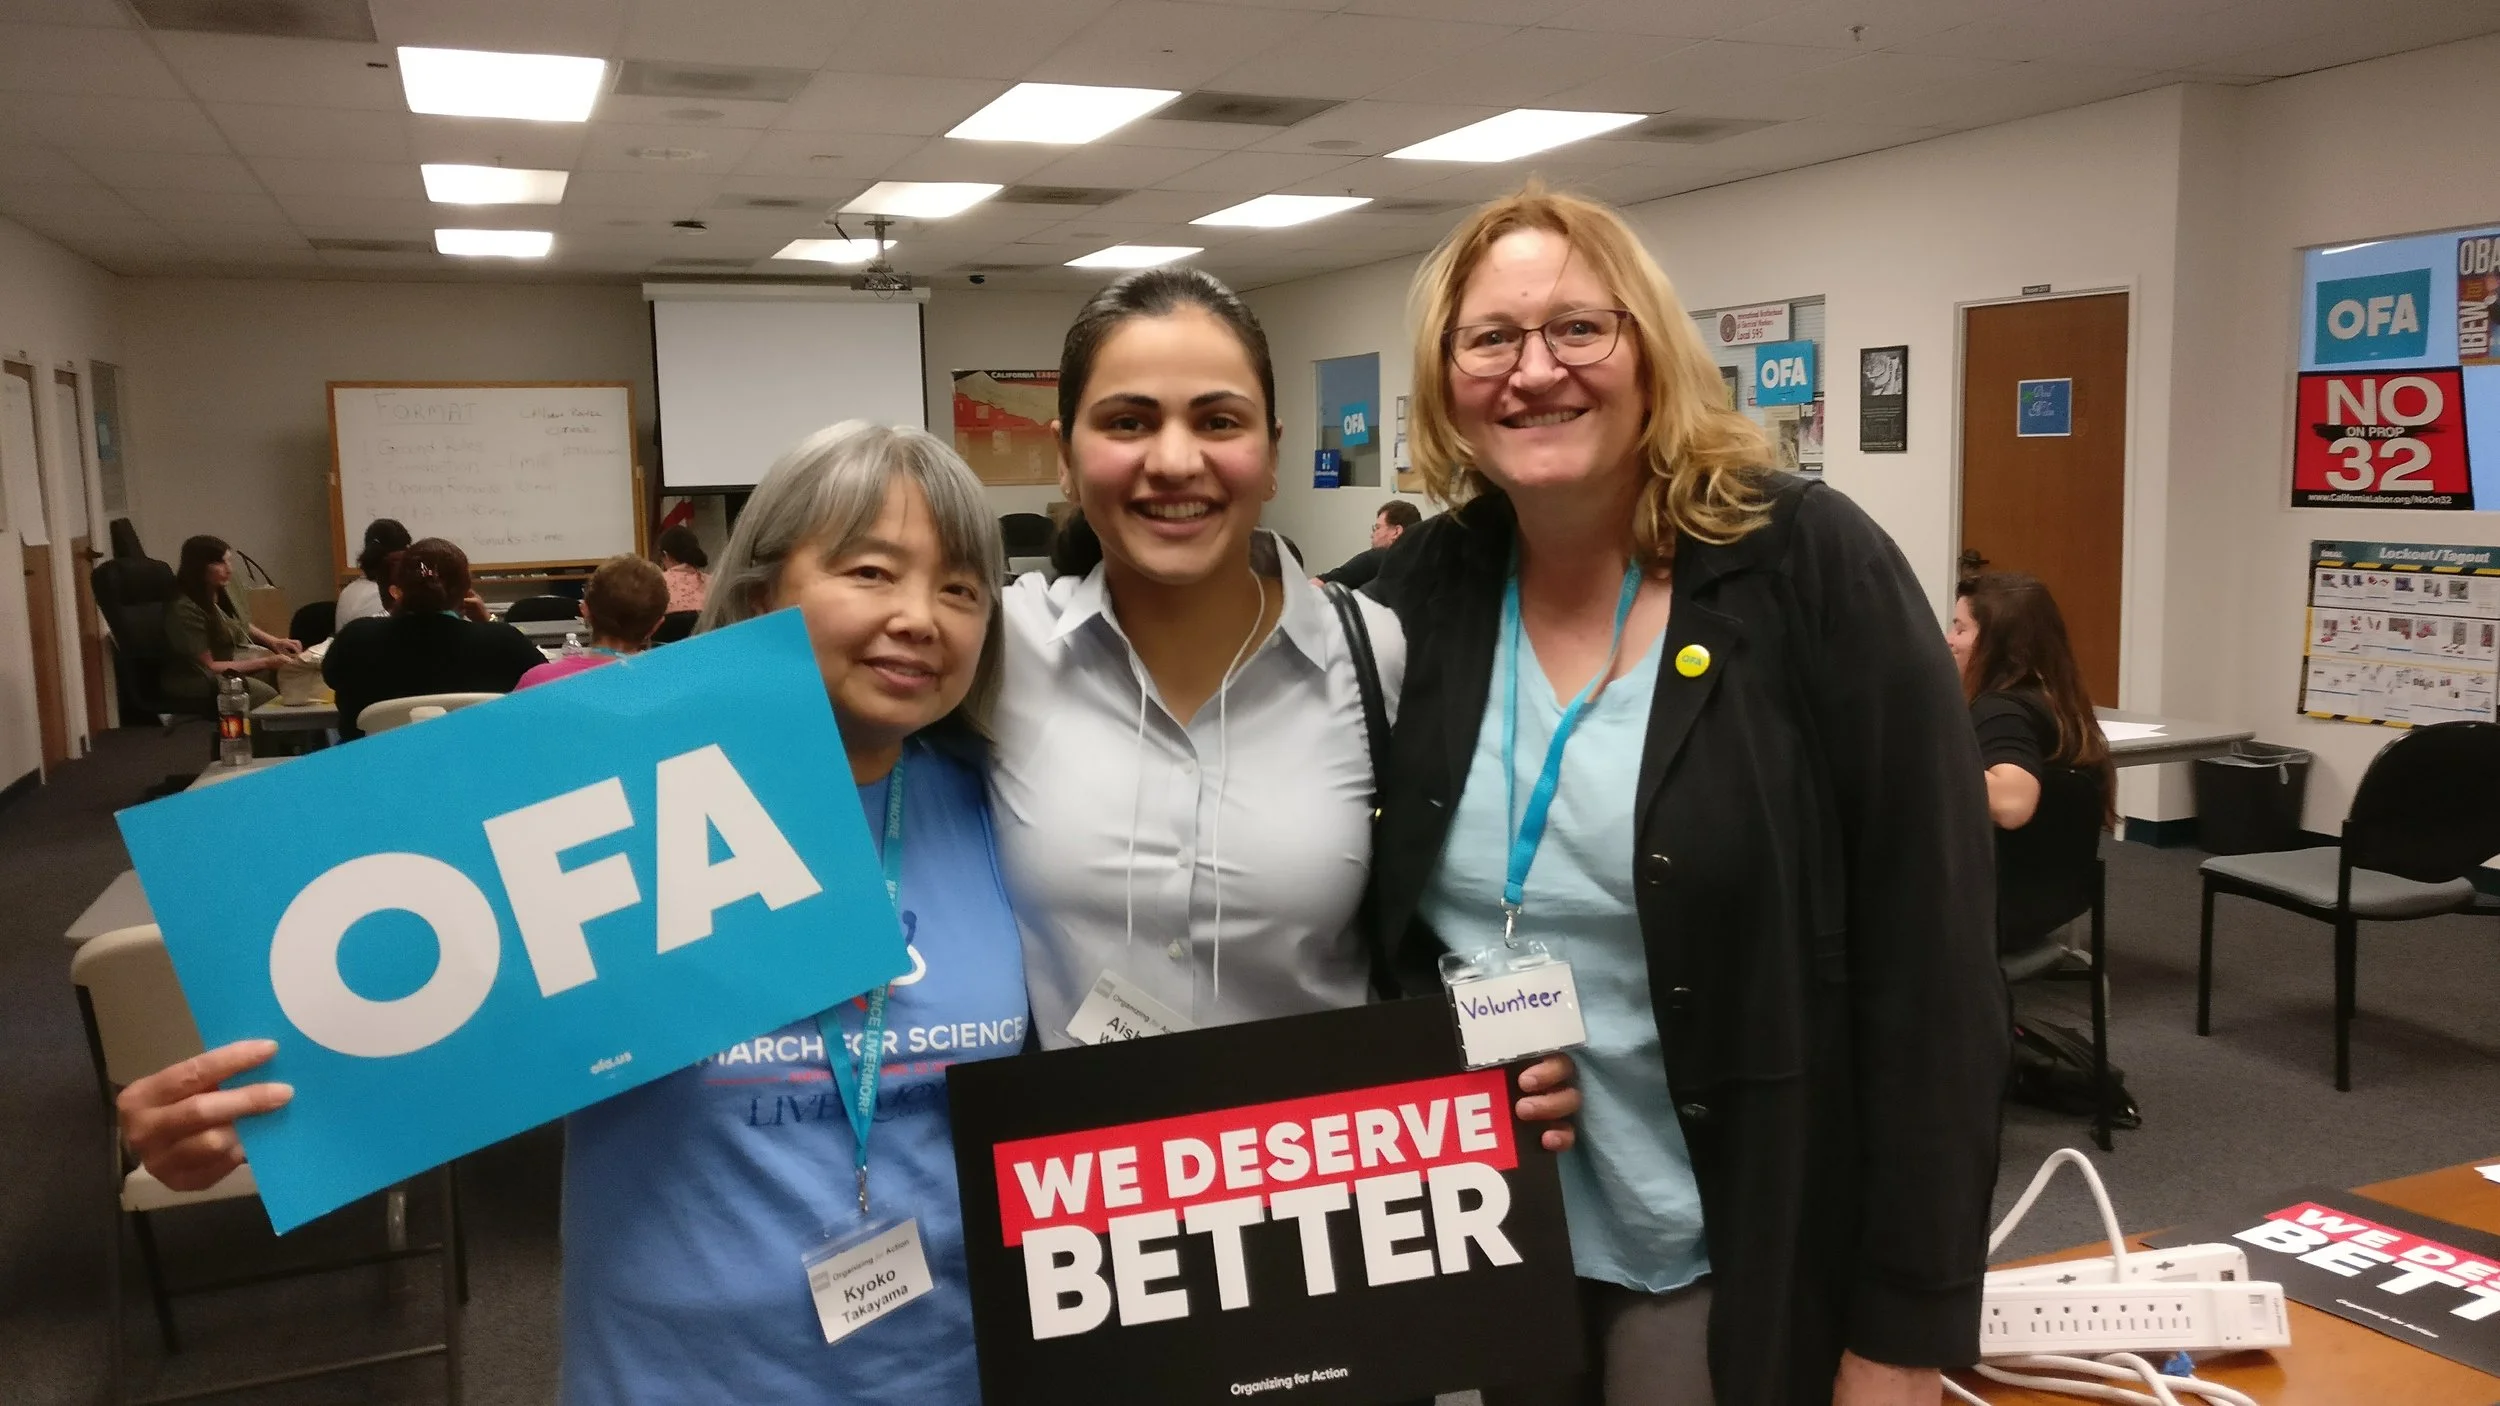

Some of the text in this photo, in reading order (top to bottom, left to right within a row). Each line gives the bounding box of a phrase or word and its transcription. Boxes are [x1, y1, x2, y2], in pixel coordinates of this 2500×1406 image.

[2327, 293, 2420, 340] OFA
[2459, 295, 2498, 355] IBEW
[1737, 330, 1750, 340] Local
[991, 371, 1035, 379] CALIFORNIA
[1761, 356, 1807, 388] OFA
[374, 393, 478, 422] FORMAT
[2326, 377, 2444, 427] NO
[1344, 412, 1365, 436] OFA
[2346, 426, 2405, 438] ON PROP
[2326, 437, 2434, 491] 32
[2308, 493, 2453, 505] www.CaliforniaLabor.org/NoOn32
[2379, 547, 2491, 565] Lockout/Tagout
[269, 743, 823, 1058] OFA
[1460, 989, 1562, 1020] Volunteer
[908, 1016, 1024, 1054] SCIENCE
[858, 1030, 879, 1117] LIVERMORE
[1013, 1092, 1499, 1219] WE DESERVE
[2295, 1208, 2402, 1249] WE
[1022, 1162, 1522, 1340] BETTER
[841, 1284, 909, 1324] Takayama
[843, 1270, 896, 1303] Kyoko
[1230, 1367, 1348, 1396] Organizing for Action
